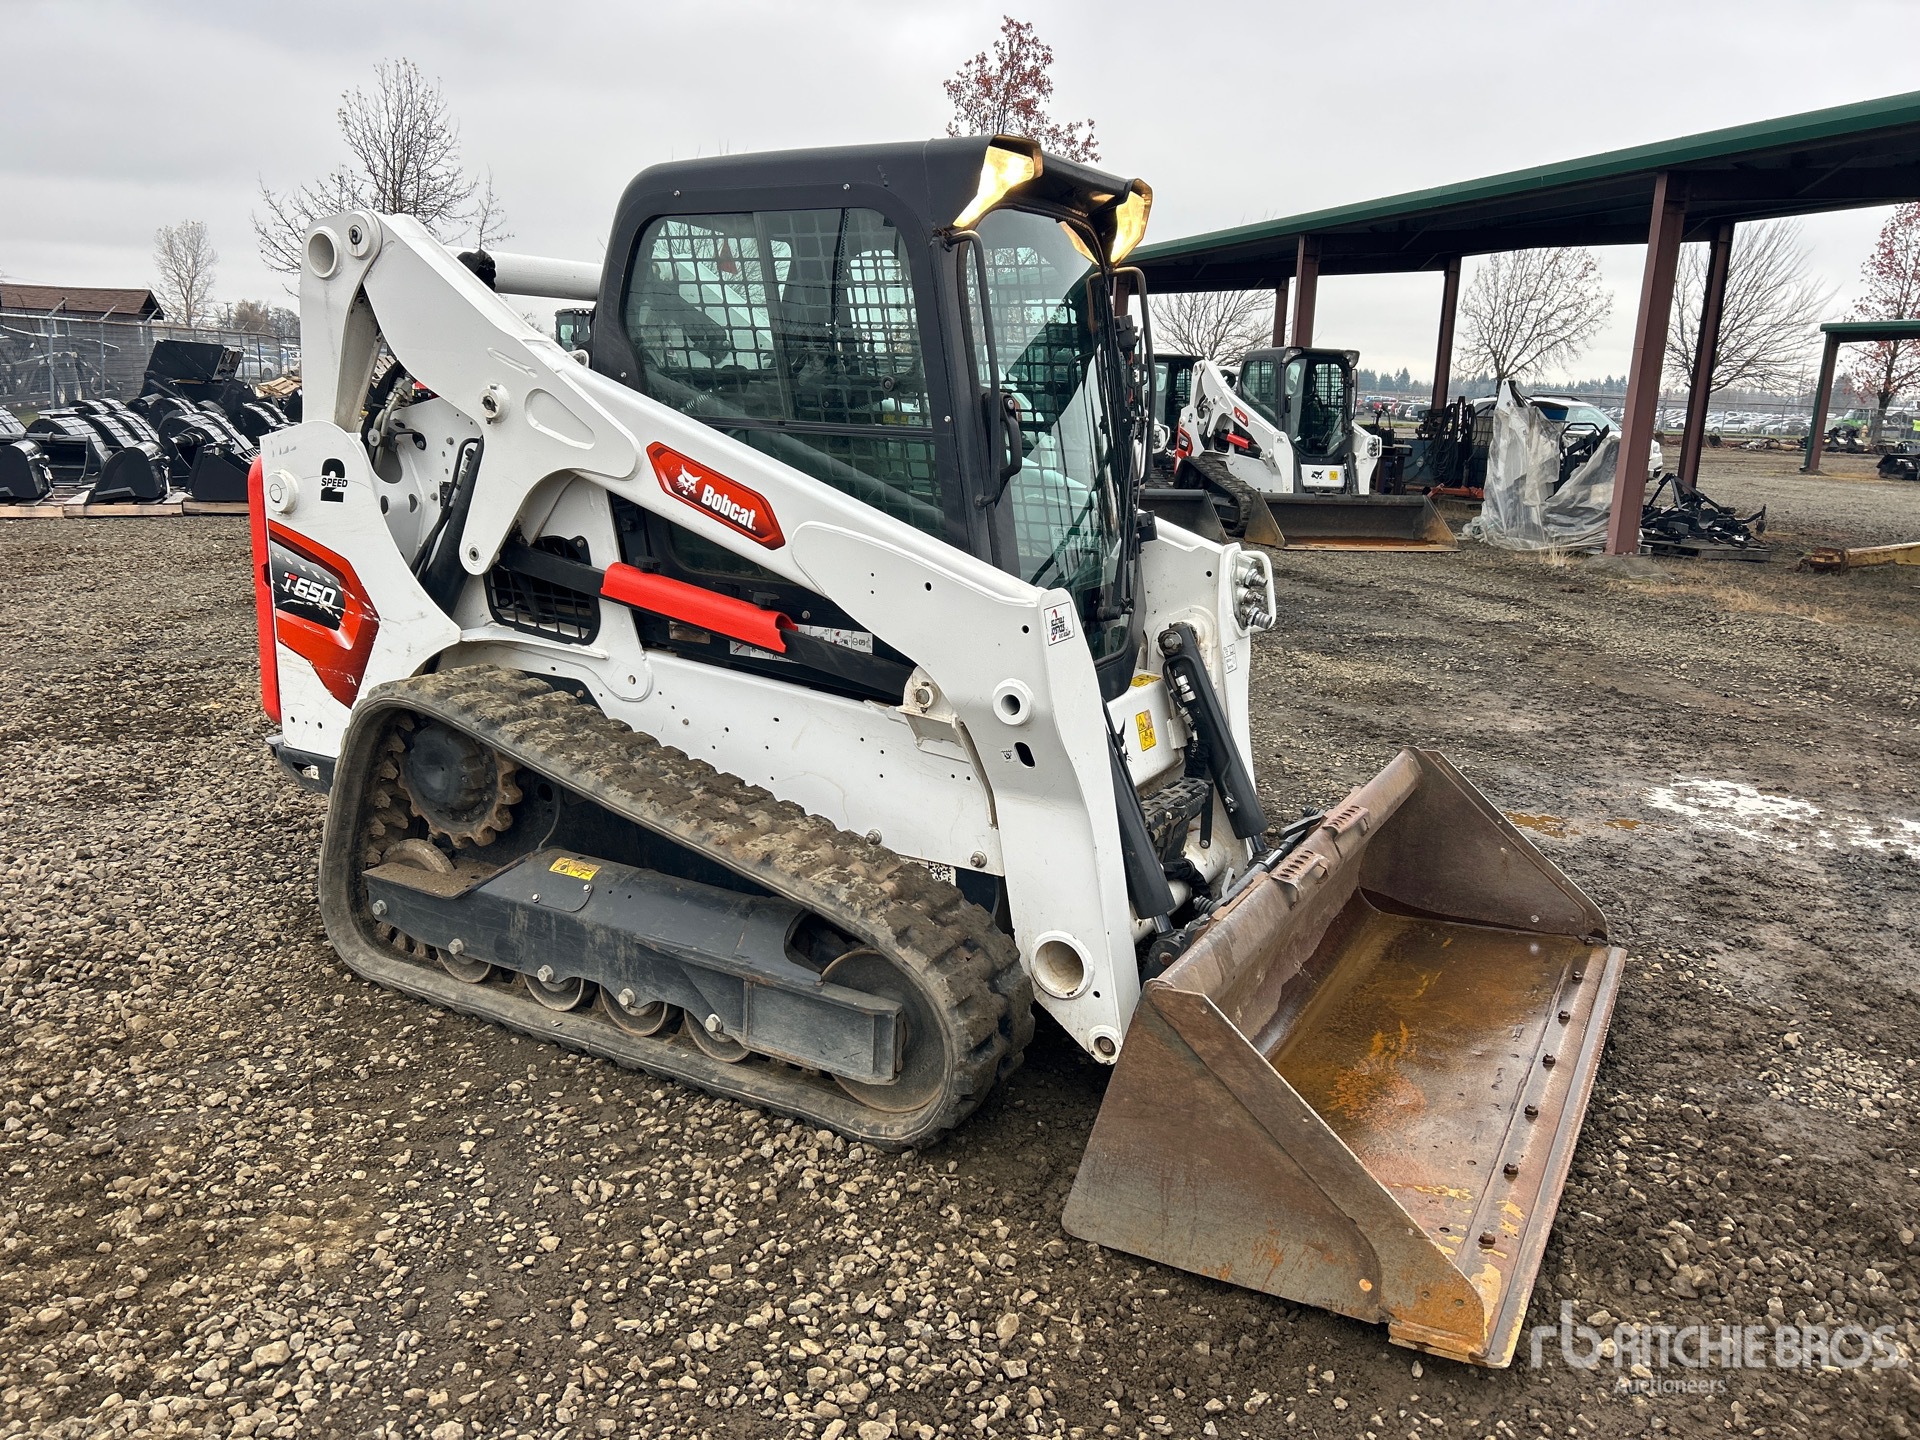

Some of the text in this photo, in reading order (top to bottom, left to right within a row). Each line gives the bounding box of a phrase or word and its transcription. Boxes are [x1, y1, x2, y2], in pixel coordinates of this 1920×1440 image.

[320, 458, 348, 503] 2 SPEED
[701, 484, 756, 530] Bobcat
[282, 571, 337, 607] T650
